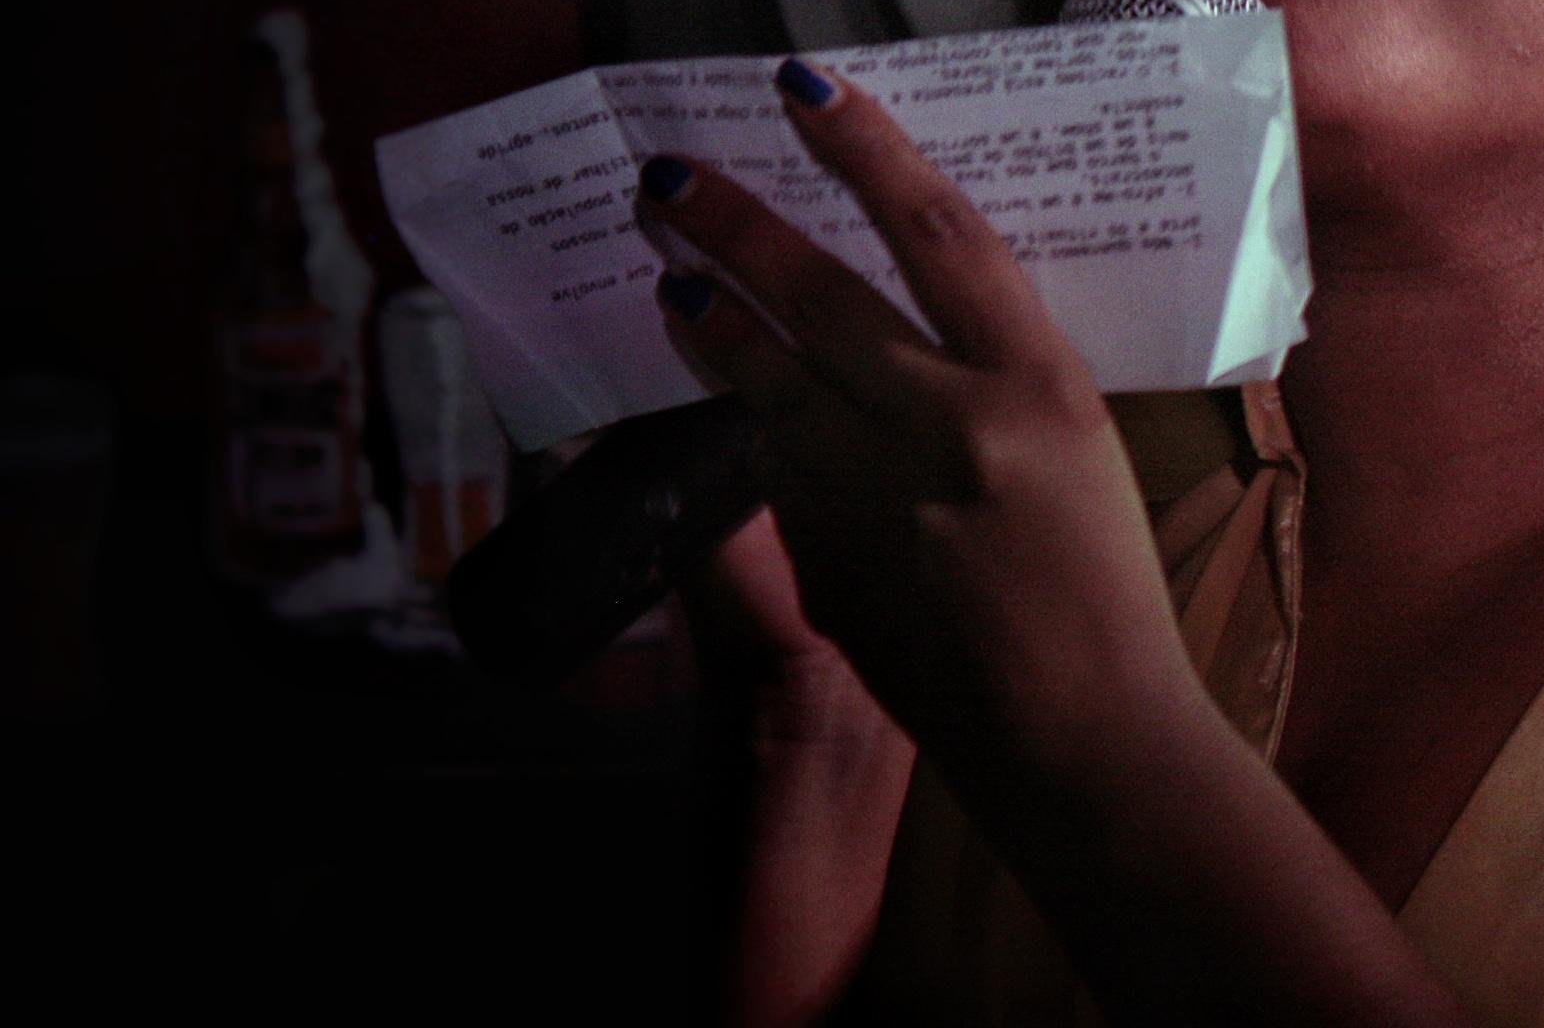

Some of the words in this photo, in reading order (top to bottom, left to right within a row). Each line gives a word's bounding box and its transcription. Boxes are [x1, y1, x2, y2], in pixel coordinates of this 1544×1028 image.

[476, 132, 534, 161] agride
[486, 184, 535, 208] nossa
[500, 221, 522, 237] de
[550, 230, 608, 253] nossos
[551, 276, 617, 303] envolve
